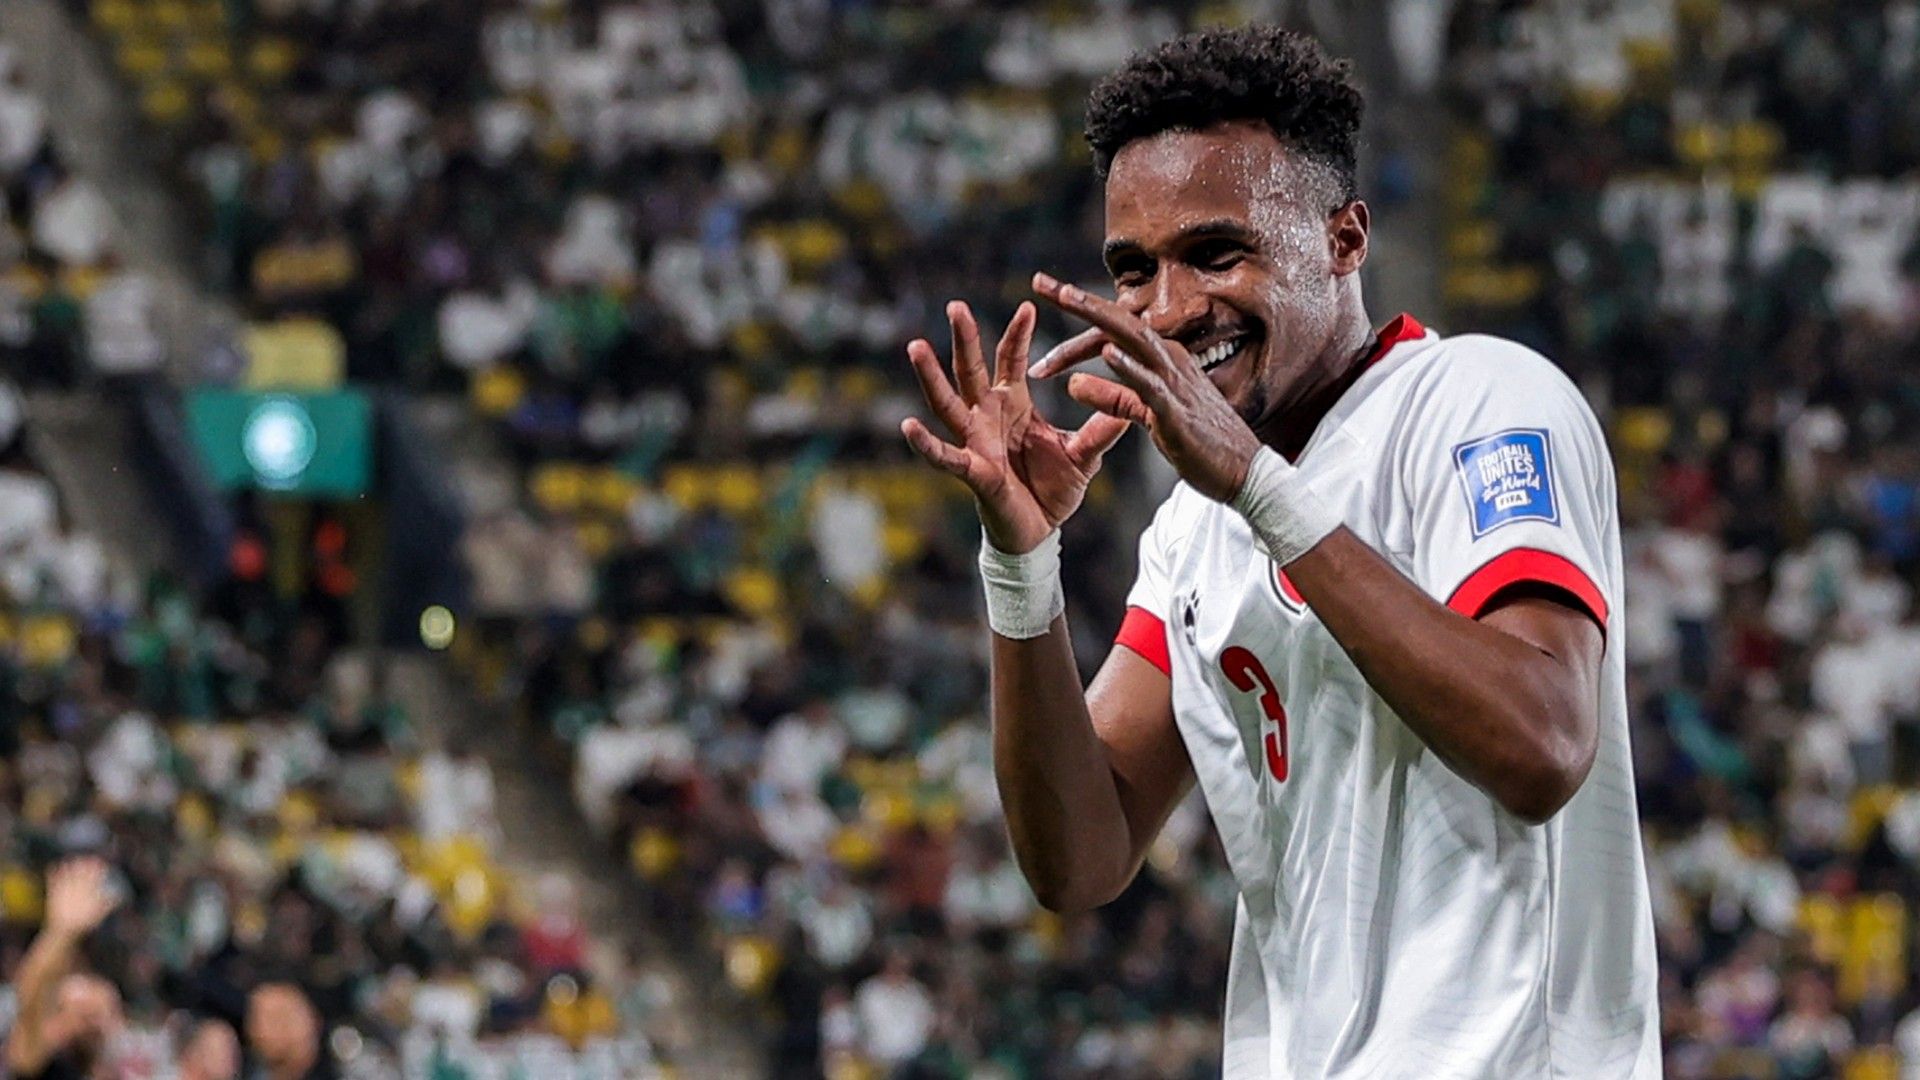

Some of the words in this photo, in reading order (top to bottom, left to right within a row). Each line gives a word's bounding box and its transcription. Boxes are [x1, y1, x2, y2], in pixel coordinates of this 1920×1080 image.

[1477, 444, 1531, 467] FOOTBALL
[1480, 456, 1534, 487] UNITES
[1501, 473, 1540, 492] World
[1500, 494, 1523, 505] FIFA
[1220, 645, 1287, 783] 3
